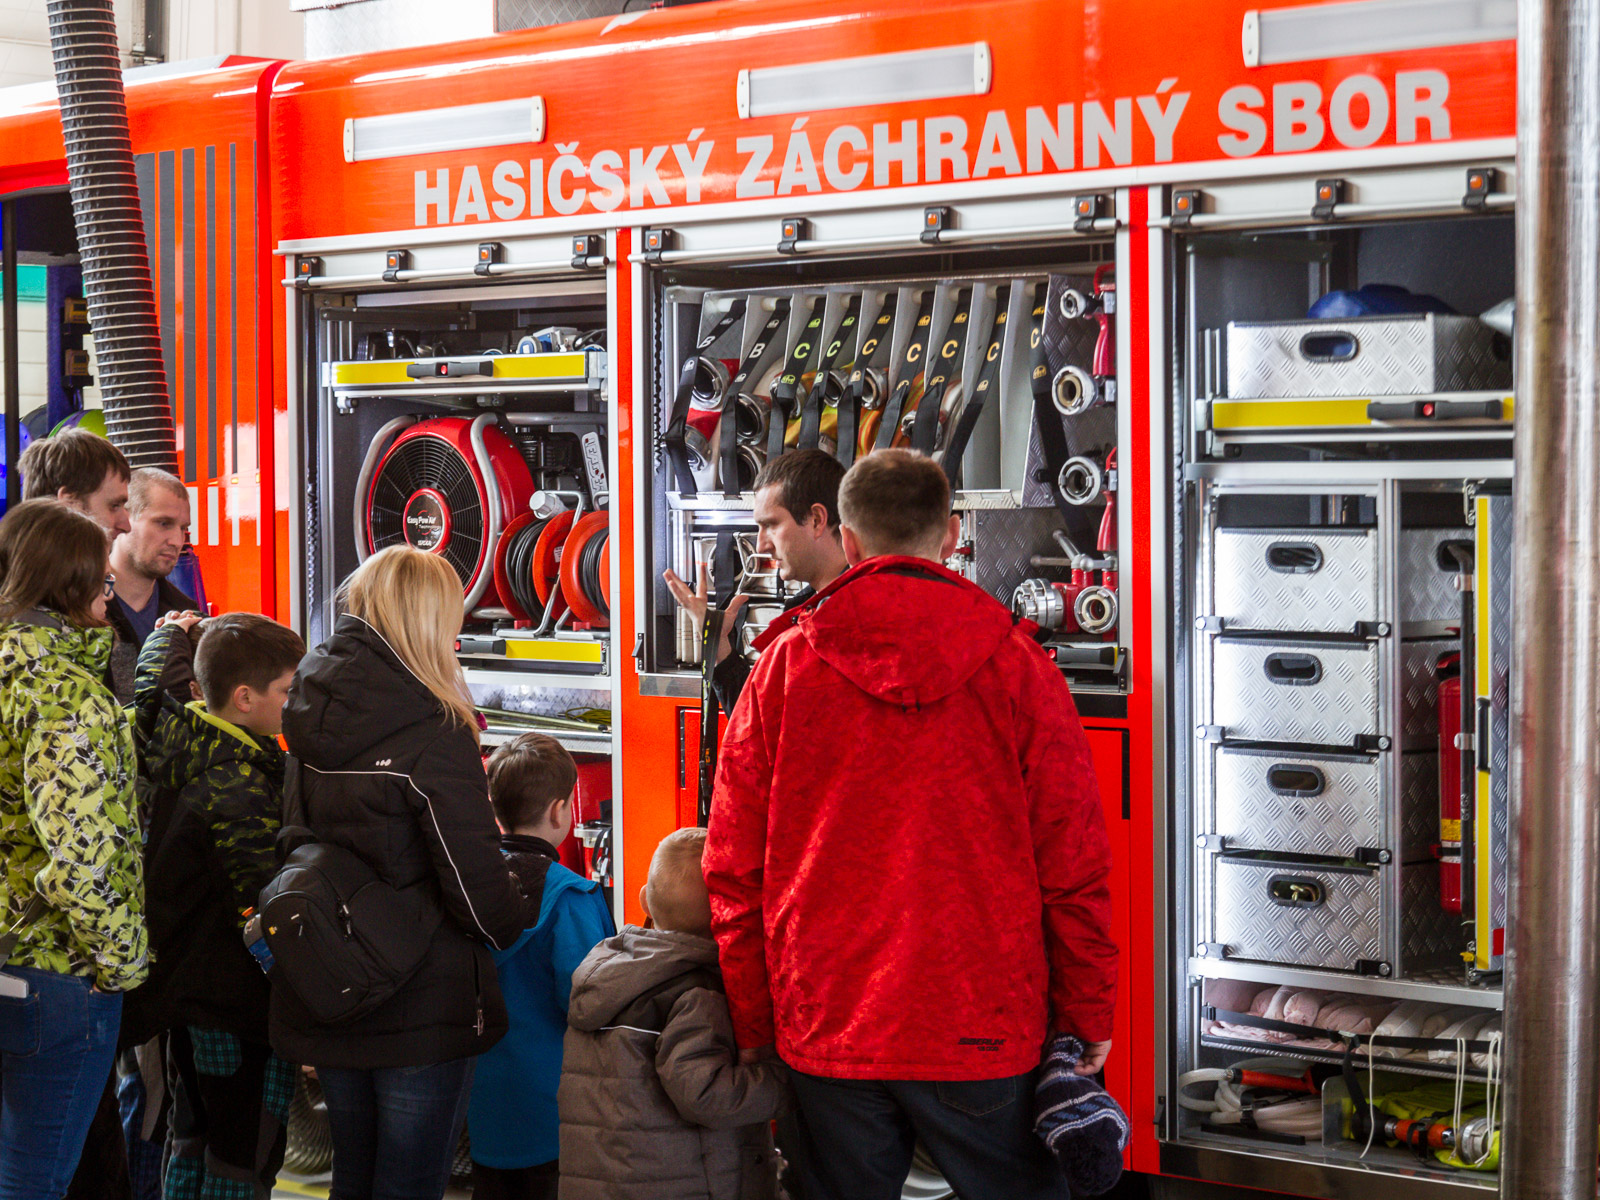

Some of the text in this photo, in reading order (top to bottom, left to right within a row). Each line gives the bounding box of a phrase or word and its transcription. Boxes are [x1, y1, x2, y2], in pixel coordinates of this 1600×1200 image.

[414, 68, 1451, 226] HASIČSKÝ ZÁCHRANNÝ SBOR
[699, 335, 716, 349] B
[862, 338, 878, 355] C
[1031, 328, 1041, 349] C
[749, 343, 766, 358] B
[794, 343, 811, 359] C
[826, 340, 841, 357] C
[906, 343, 922, 362] C
[941, 340, 958, 358] C
[986, 342, 1000, 362] C
